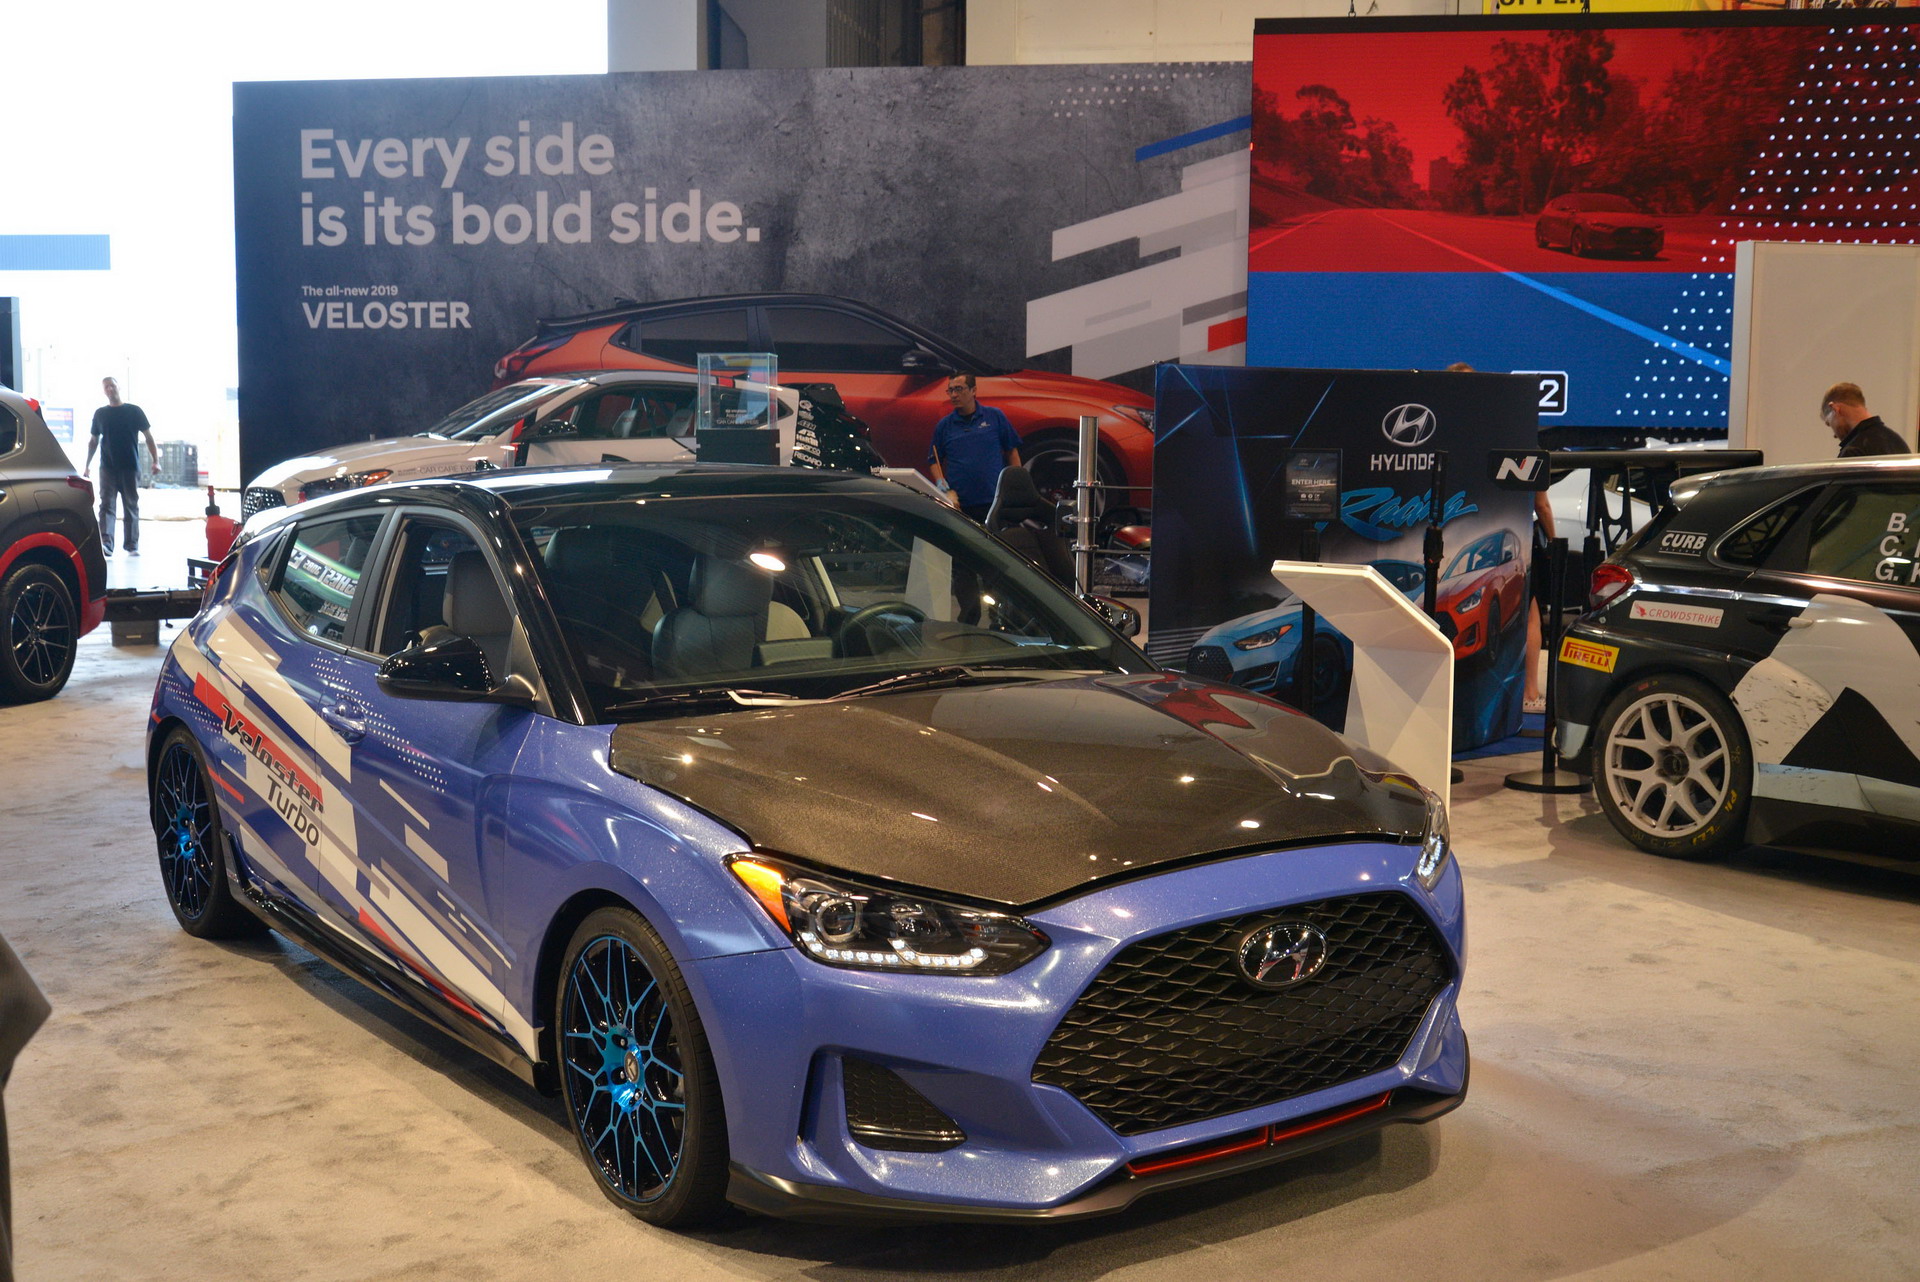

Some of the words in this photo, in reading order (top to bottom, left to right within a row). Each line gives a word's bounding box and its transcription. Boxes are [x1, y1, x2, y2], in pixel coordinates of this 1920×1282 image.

[301, 128, 471, 188] Every
[483, 121, 615, 176] side
[301, 192, 347, 246] is
[363, 191, 436, 246] its
[452, 191, 592, 245] bold
[609, 187, 761, 243] side.
[302, 285, 323, 296] The
[326, 285, 369, 296] all-new
[371, 285, 398, 296] 2019
[302, 301, 472, 329] VELOSTER
[793, 450, 822, 467] RECARO
[1370, 452, 1442, 472] HYUNDA
[420, 466, 436, 474] CAR
[439, 465, 458, 473] CARE
[1291, 478, 1312, 486] ENTER
[1886, 512, 1910, 533] B.
[1661, 533, 1707, 550] CURB
[1880, 535, 1903, 557] C.
[1648, 607, 1721, 626] CROWDSTRIKE
[1563, 641, 1613, 668] PIRELLI
[222, 703, 324, 814] Veloster
[267, 774, 320, 848] Turbo
